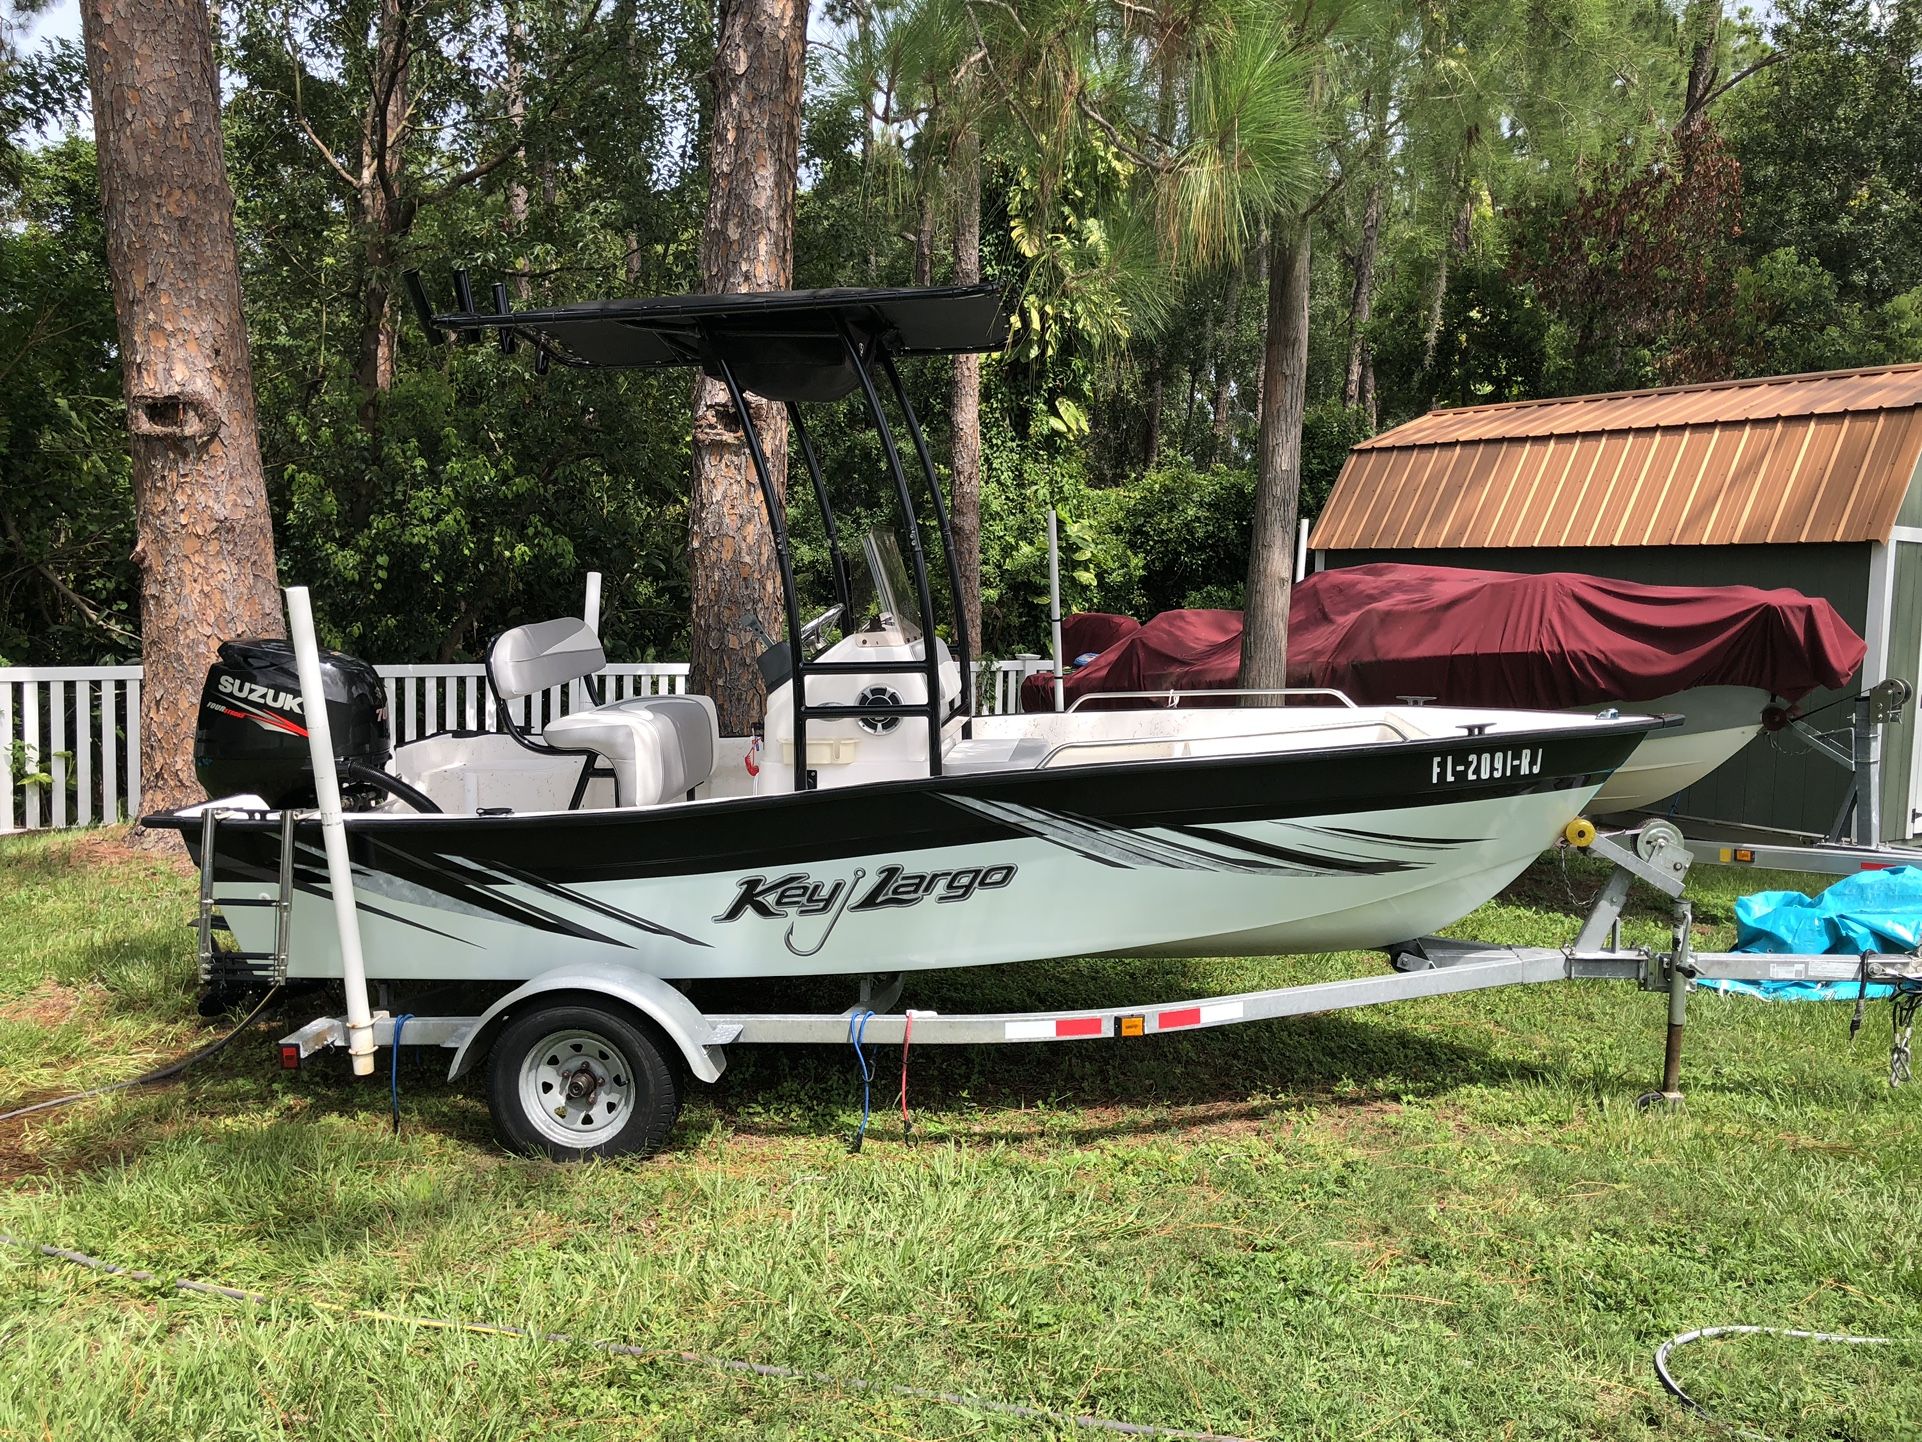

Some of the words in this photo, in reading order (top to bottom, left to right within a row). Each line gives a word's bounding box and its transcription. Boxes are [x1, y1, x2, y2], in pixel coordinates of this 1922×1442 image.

[218, 675, 305, 715] SUZUK
[1432, 748, 1543, 784] FL-2091-RJ
[711, 873, 845, 923] Key
[847, 863, 1018, 912] Largo
